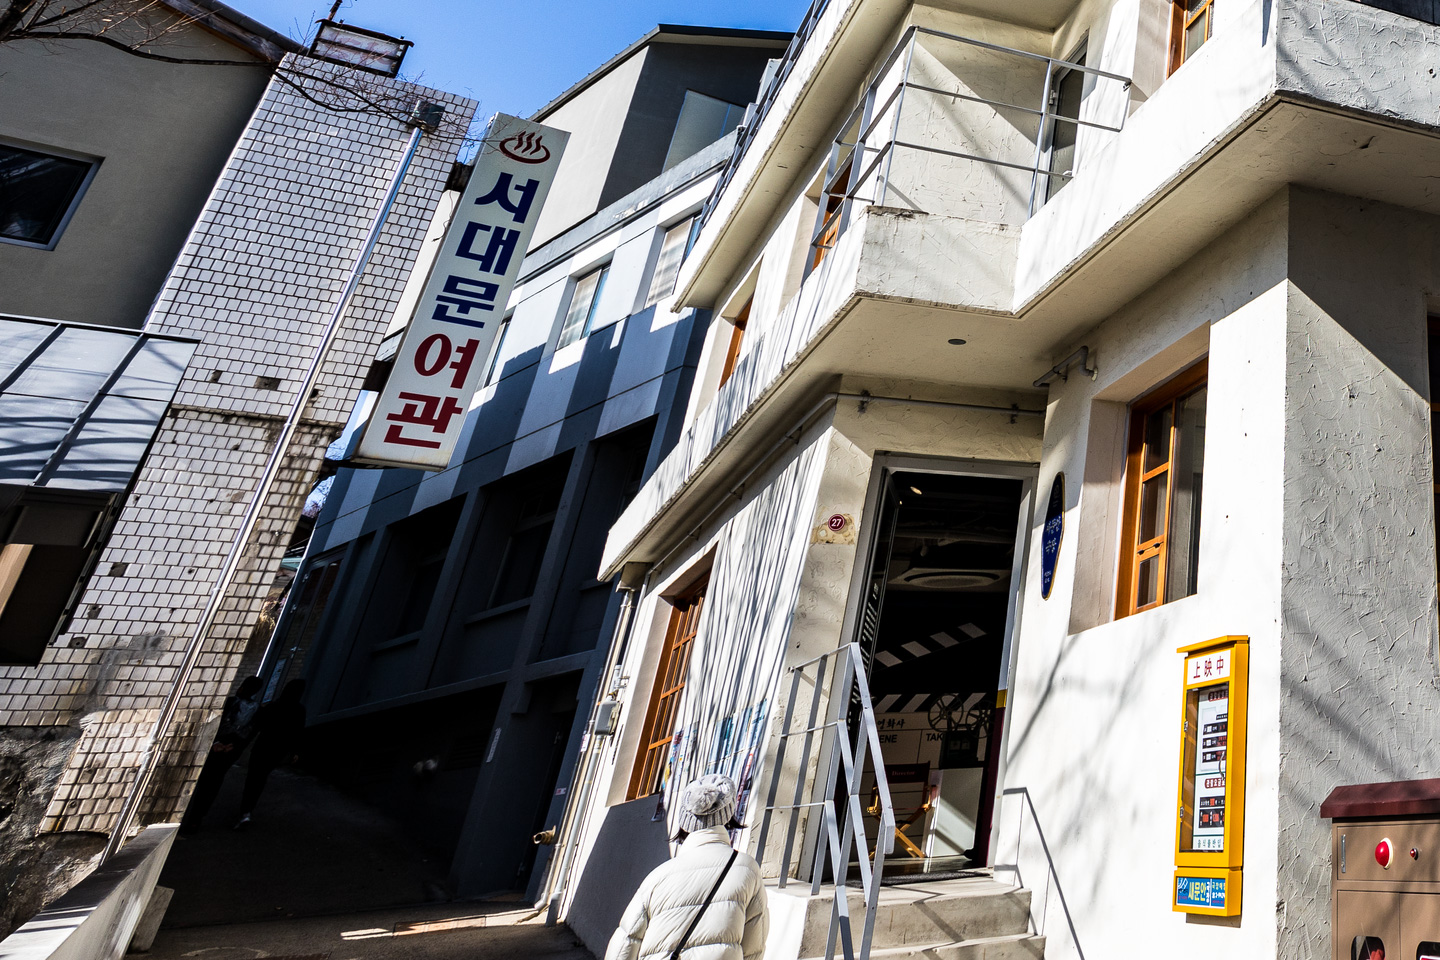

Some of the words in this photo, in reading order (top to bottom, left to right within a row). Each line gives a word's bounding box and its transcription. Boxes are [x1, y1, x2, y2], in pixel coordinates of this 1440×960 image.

[383, 171, 540, 449] 서대문여관
[831, 518, 842, 527] 27
[1193, 655, 1224, 679] 上映中
[926, 733, 943, 742] TAK
